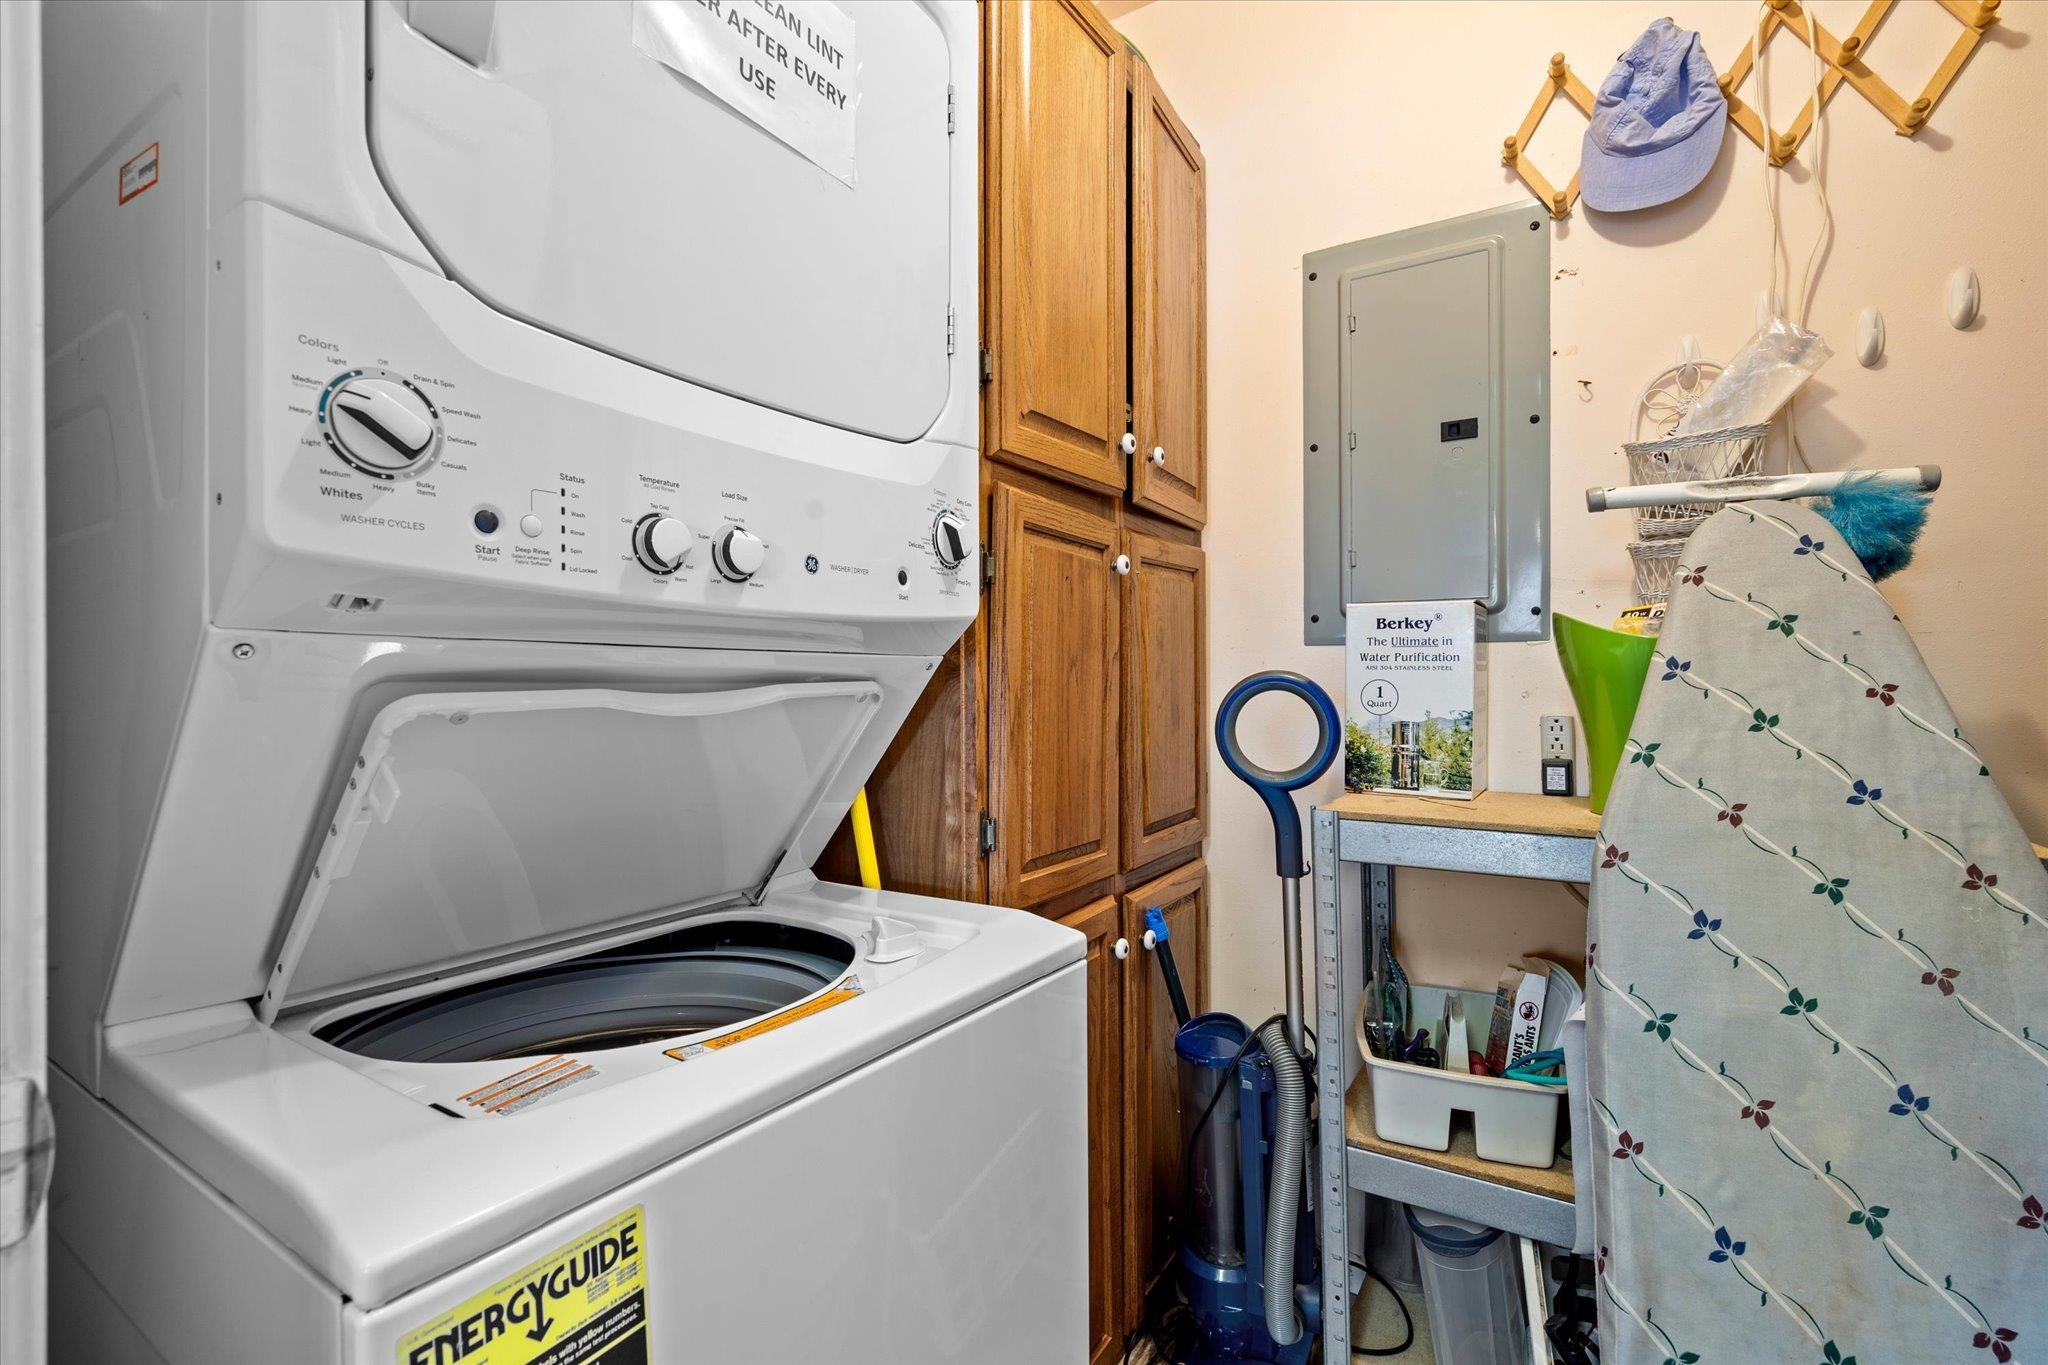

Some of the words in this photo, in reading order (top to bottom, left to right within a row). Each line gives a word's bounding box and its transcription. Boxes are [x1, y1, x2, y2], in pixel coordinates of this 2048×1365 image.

[807, 27, 844, 70] LINT
[727, 8, 788, 68] AFTER
[794, 56, 847, 110] EVERY
[739, 56, 776, 100] USE
[297, 334, 340, 352] Colors
[327, 355, 347, 366] Light
[377, 358, 389, 367] Off
[291, 374, 323, 386] Medium
[413, 374, 432, 384] Drain
[440, 380, 456, 389] Spin
[288, 405, 313, 416] Heavy
[441, 406, 463, 416] Speed
[463, 410, 482, 420] Wash
[300, 437, 322, 447] Light
[446, 435, 478, 447] Delicates
[440, 460, 468, 471] Casuals
[319, 468, 352, 479] Medium
[559, 473, 586, 484] Status
[415, 480, 436, 490] Bulky
[638, 474, 681, 489] Temperature
[319, 485, 364, 501] Whites
[372, 483, 395, 493] Heavy
[416, 489, 437, 498] Items
[721, 491, 736, 500] Load
[736, 493, 748, 502] Size
[340, 513, 386, 526] WASHER
[387, 519, 426, 531] CYCLES
[570, 529, 585, 537] Rinse
[474, 544, 501, 555] Start
[515, 545, 532, 555] Deep
[532, 547, 550, 556] Rinse
[570, 547, 583, 555] Spin
[1366, 636, 1388, 646] The
[1391, 636, 1439, 647] Ultimate
[1442, 636, 1453, 646] in
[1359, 652, 1391, 662] Water
[1394, 652, 1460, 662] Purification
[1377, 685, 1384, 699] 1
[1366, 699, 1392, 708] Quart
[1524, 1025, 1536, 1049] ANTS
[558, 1340, 577, 1358] with
[577, 1324, 604, 1347] yellow
[605, 1301, 641, 1328] numbers.
[575, 1342, 592, 1358] same
[592, 1334, 604, 1347] test
[604, 1312, 638, 1340] procedures.
